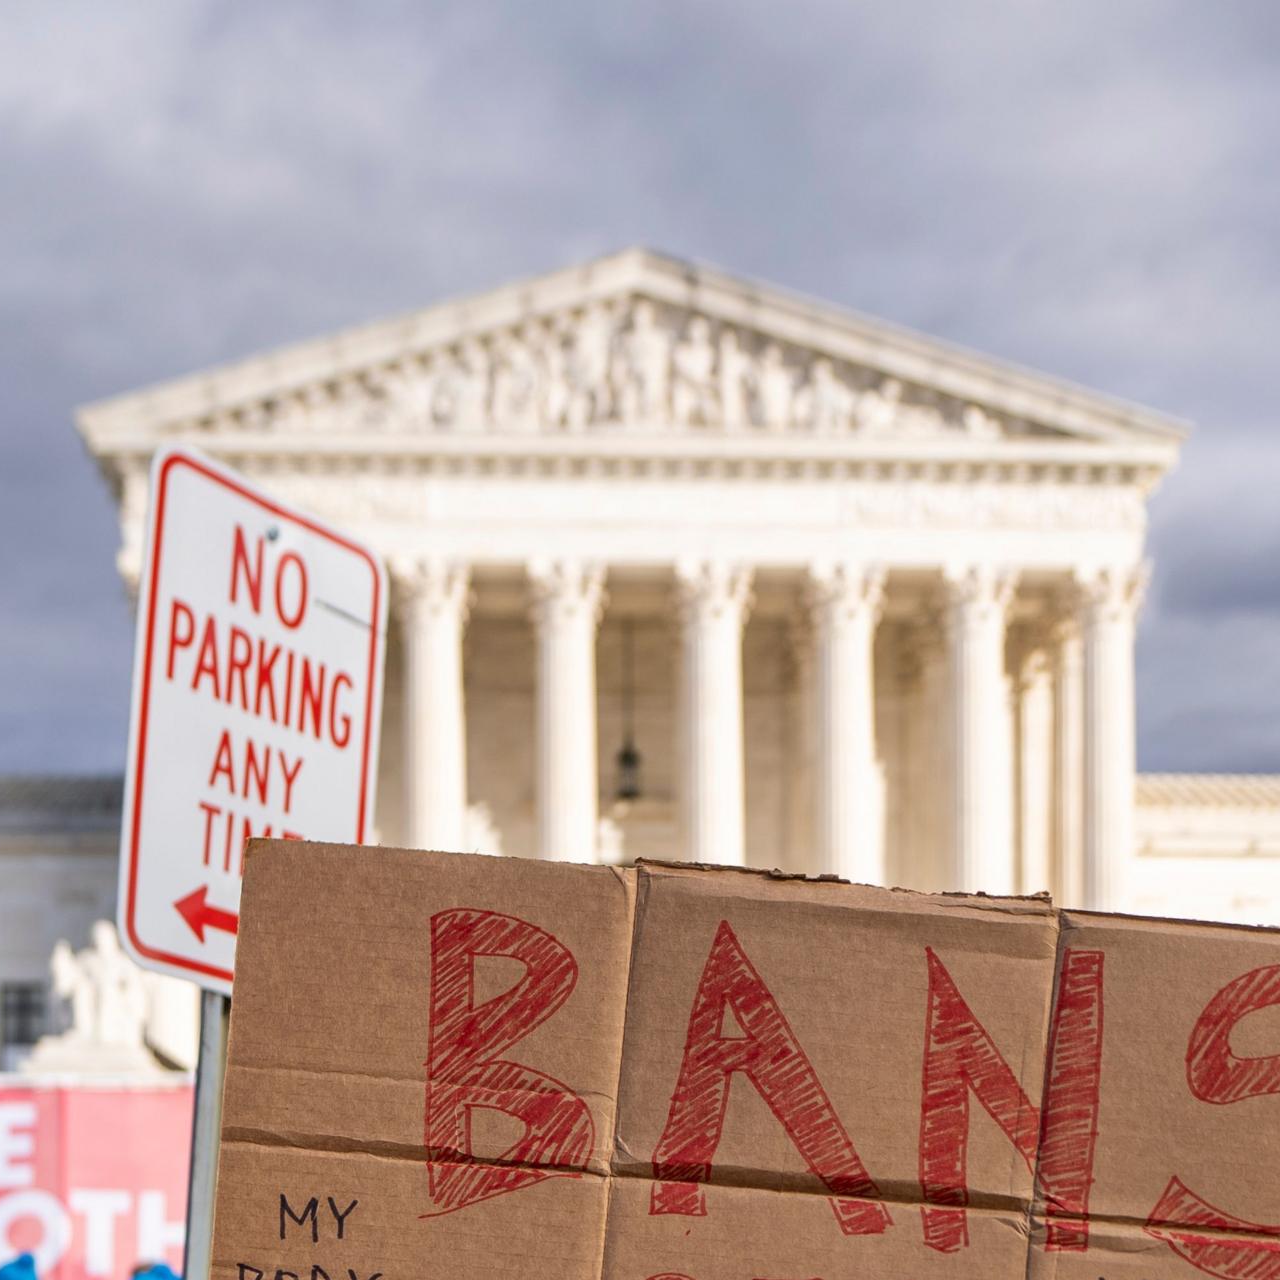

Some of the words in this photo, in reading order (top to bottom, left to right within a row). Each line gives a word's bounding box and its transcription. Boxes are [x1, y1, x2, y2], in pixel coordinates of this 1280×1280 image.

[228, 522, 309, 630] NO
[165, 598, 354, 749] PARKING
[208, 728, 303, 815] ANY
[277, 1194, 359, 1243] MY
